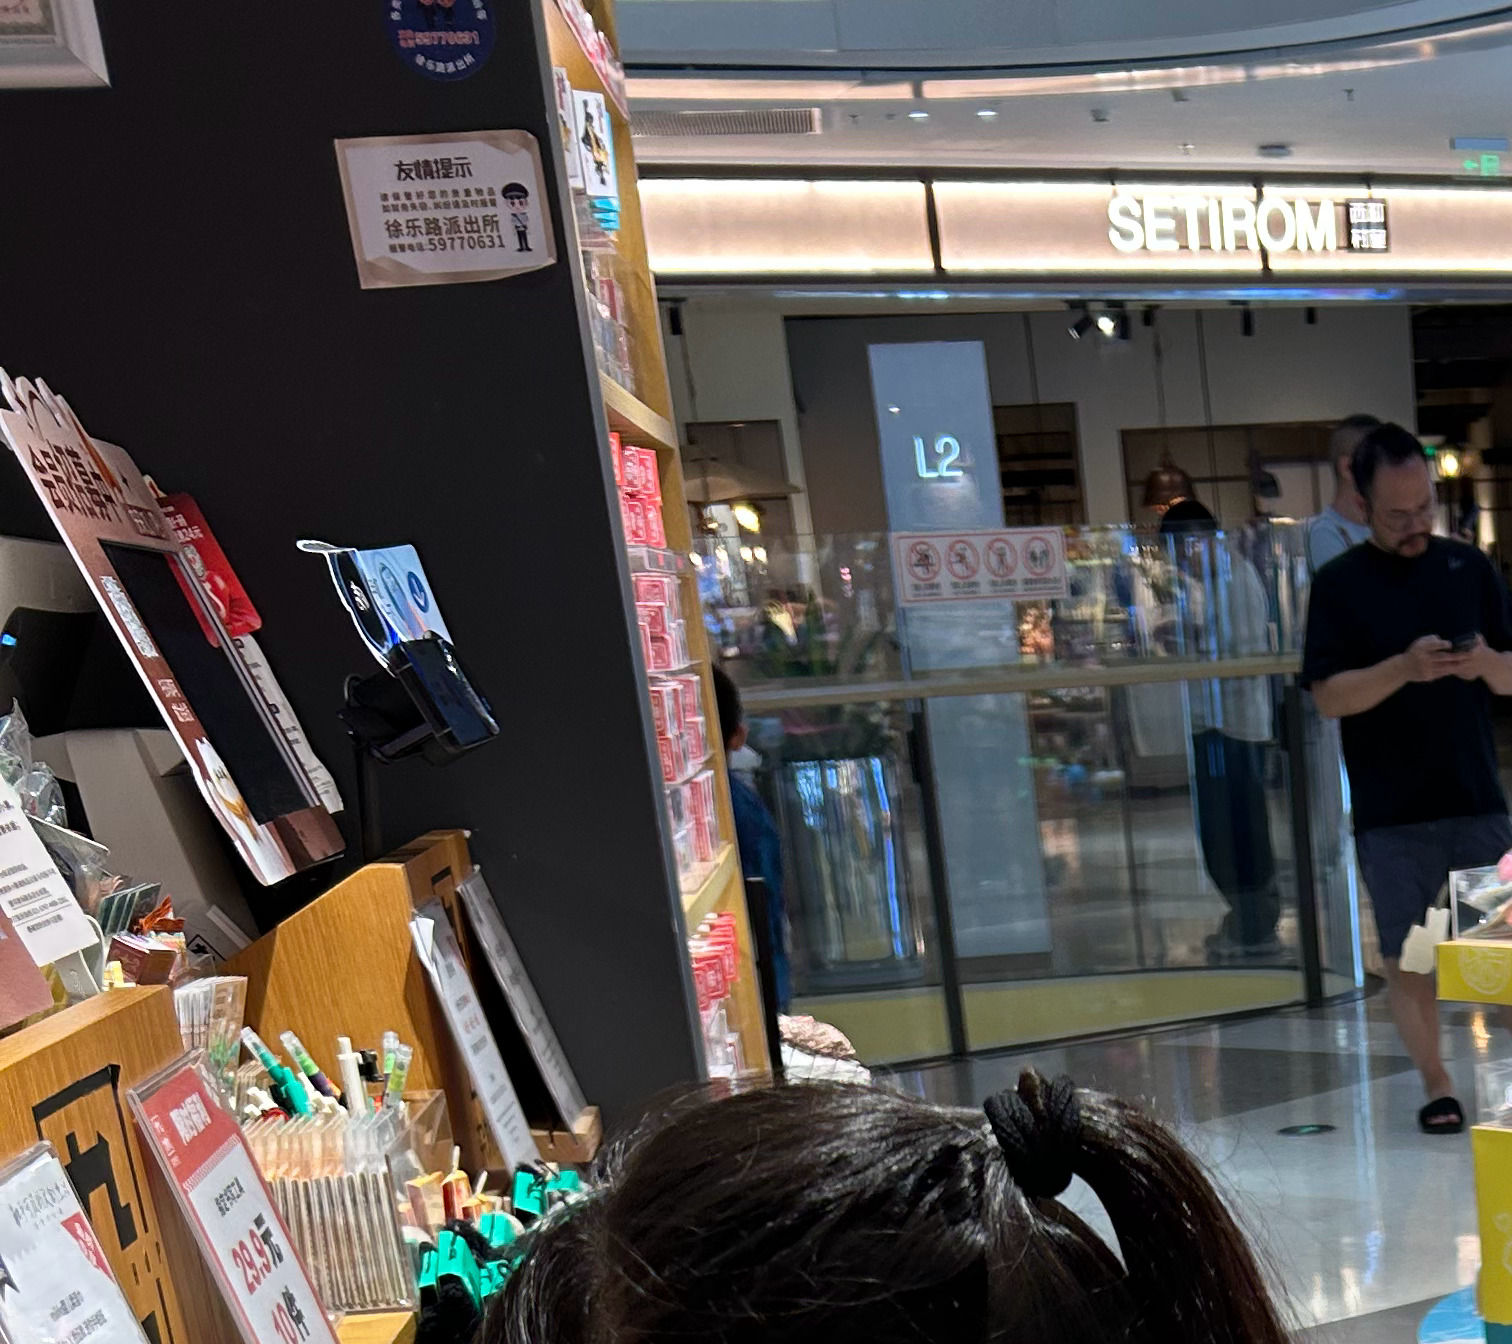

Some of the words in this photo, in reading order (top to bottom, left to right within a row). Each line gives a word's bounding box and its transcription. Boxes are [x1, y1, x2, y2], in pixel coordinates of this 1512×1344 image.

[394, 157, 473, 181] 友情提示
[385, 214, 500, 239] 徐乐路派出所
[1108, 196, 1337, 252] SETIROM
[913, 434, 963, 479] L2
[231, 1213, 283, 1296] 29.9元
